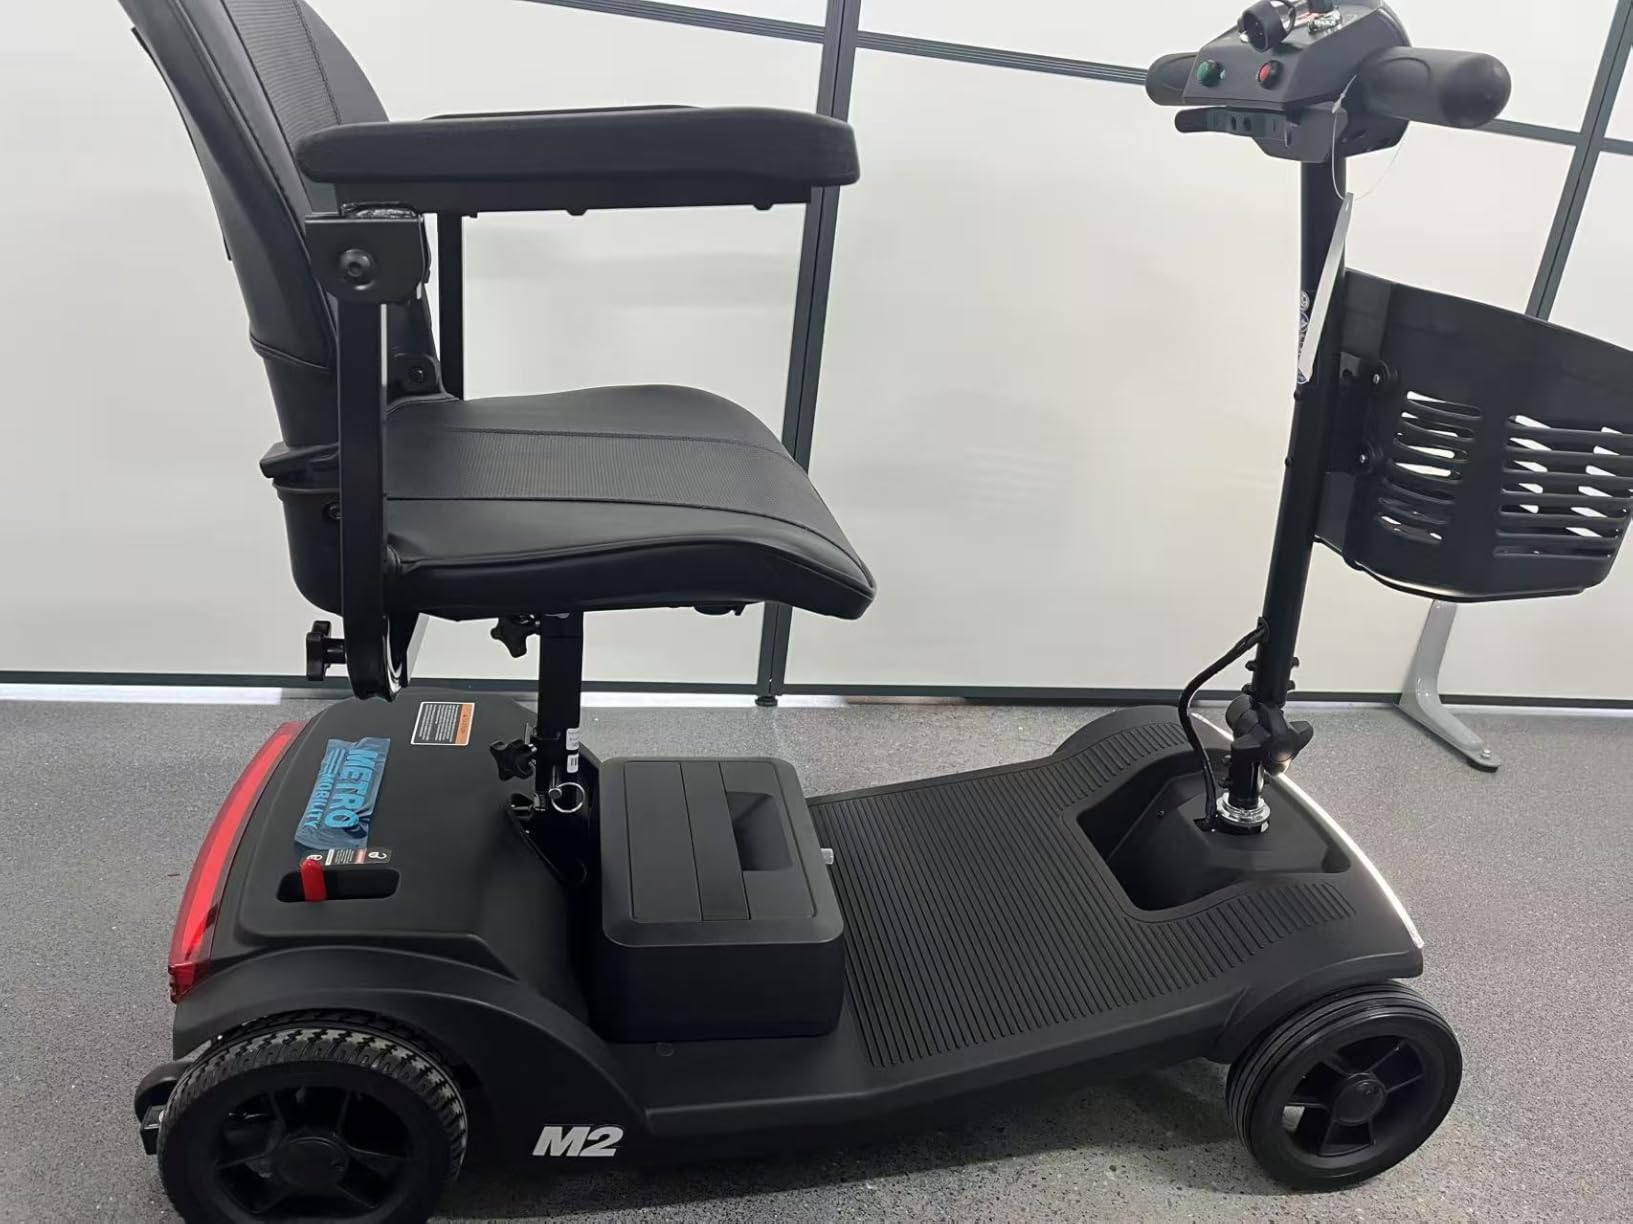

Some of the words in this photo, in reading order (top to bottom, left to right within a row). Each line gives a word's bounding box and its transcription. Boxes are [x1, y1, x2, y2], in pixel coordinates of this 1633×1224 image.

[303, 773, 335, 829] MOBILITY
[325, 749, 378, 828] METRO
[532, 1126, 624, 1157] M2
